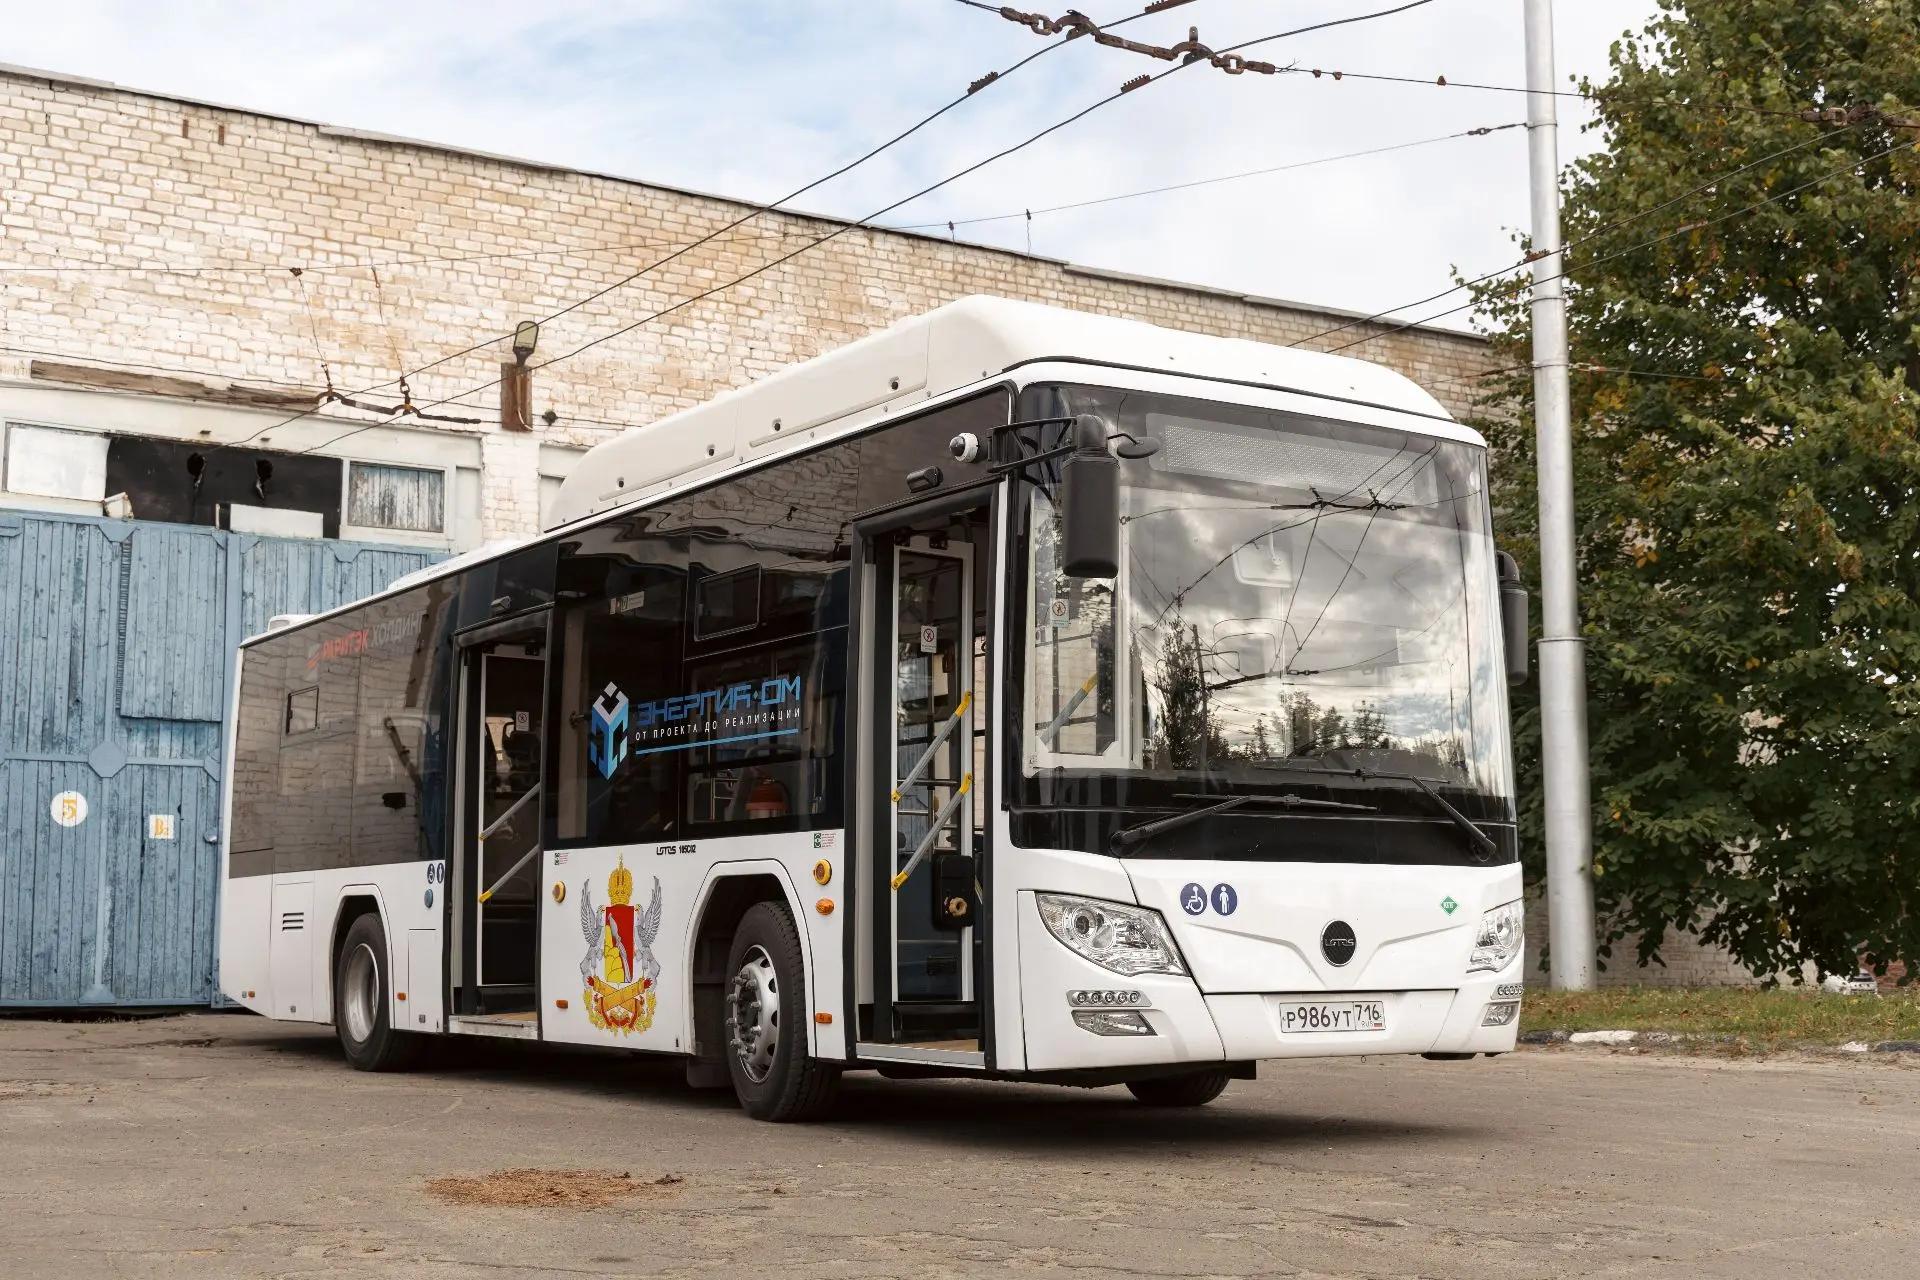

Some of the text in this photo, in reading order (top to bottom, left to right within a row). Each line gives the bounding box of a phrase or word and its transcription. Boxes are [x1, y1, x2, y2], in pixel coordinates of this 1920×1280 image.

[635, 707, 801, 741] ОТ ПРОЕКТА ДО РЕАЛИЗАЦИИ
[62, 798, 77, 819] 5
[1287, 1004, 1380, 1029] Р986УТ 716
